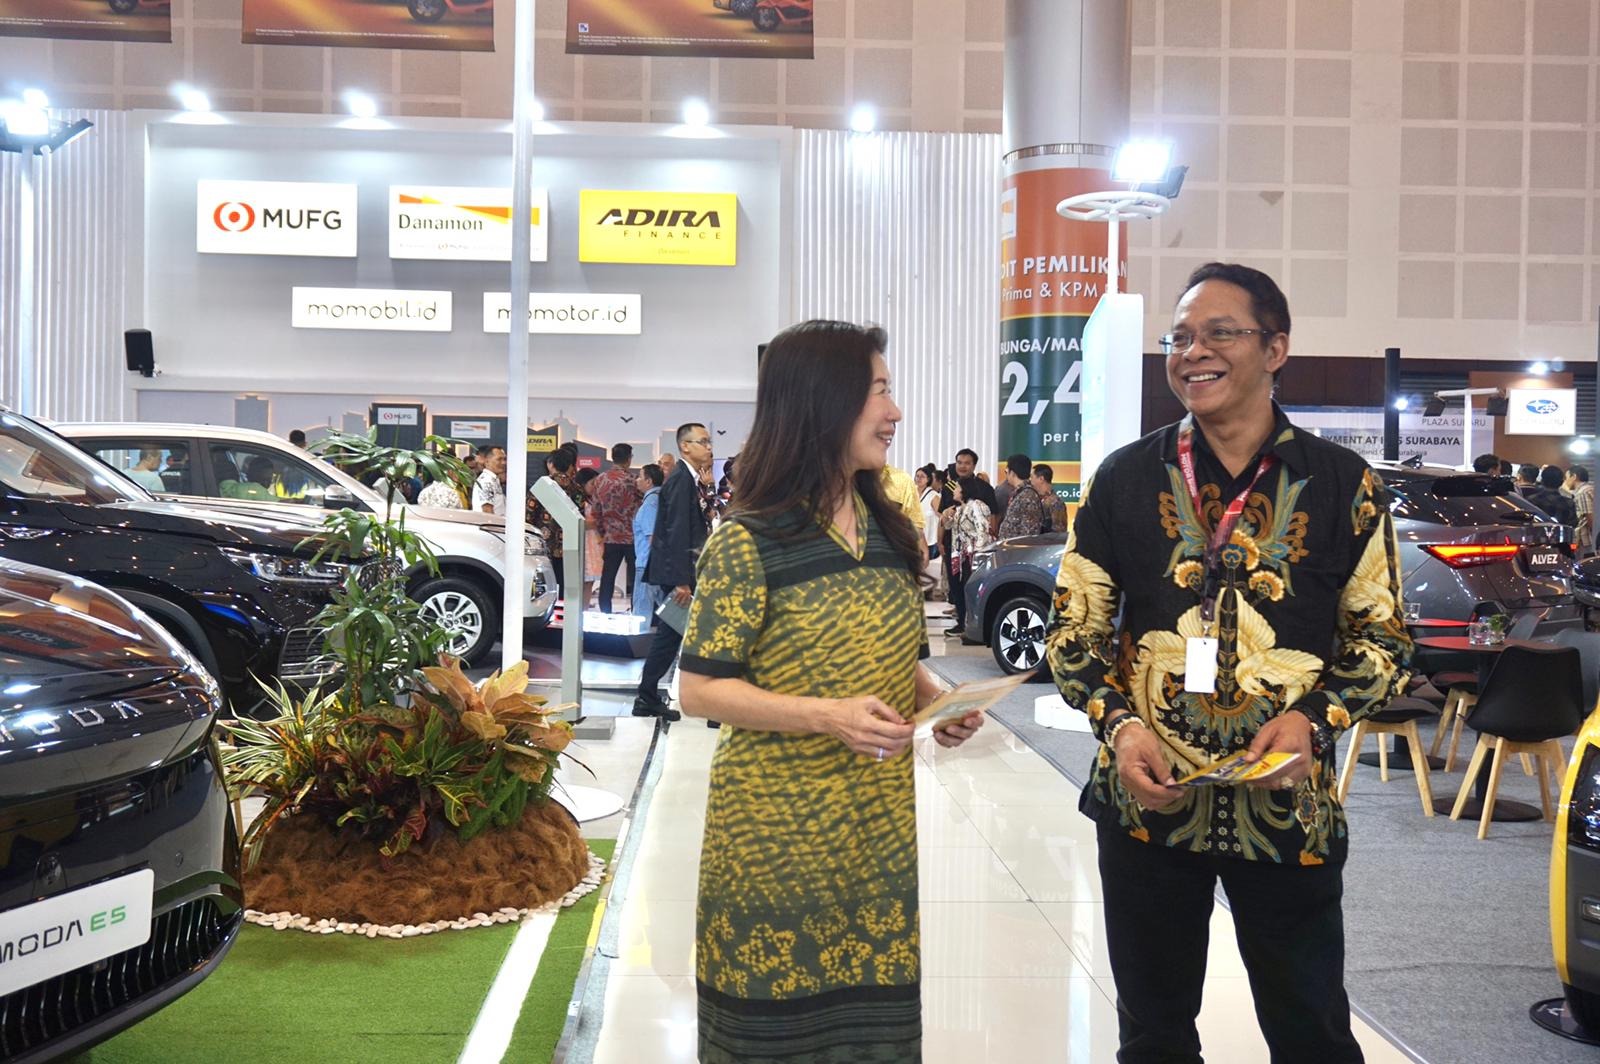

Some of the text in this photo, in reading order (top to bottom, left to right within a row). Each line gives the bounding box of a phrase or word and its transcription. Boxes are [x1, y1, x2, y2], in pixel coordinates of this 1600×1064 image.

[263, 208, 342, 230] MUFG
[398, 213, 483, 231] Danamon
[596, 208, 721, 228] ADIRA
[623, 230, 721, 240] FINANCE
[1023, 255, 1128, 278] PEMILIKN
[1039, 282, 1052, 298] &
[1060, 282, 1098, 298] KPM
[308, 299, 437, 320] momobil.id
[498, 304, 627, 323] mmotor.id
[1001, 337, 1083, 355] BUNGA/MA
[1422, 417, 1486, 427] PLAZA SURU
[1043, 431, 1070, 446] per
[1323, 435, 1363, 445] YMENT
[1365, 436, 1378, 445] AT
[1405, 436, 1460, 446] SURABAYA
[1531, 553, 1559, 565] ALVEZ
[90, 905, 126, 932] E5
